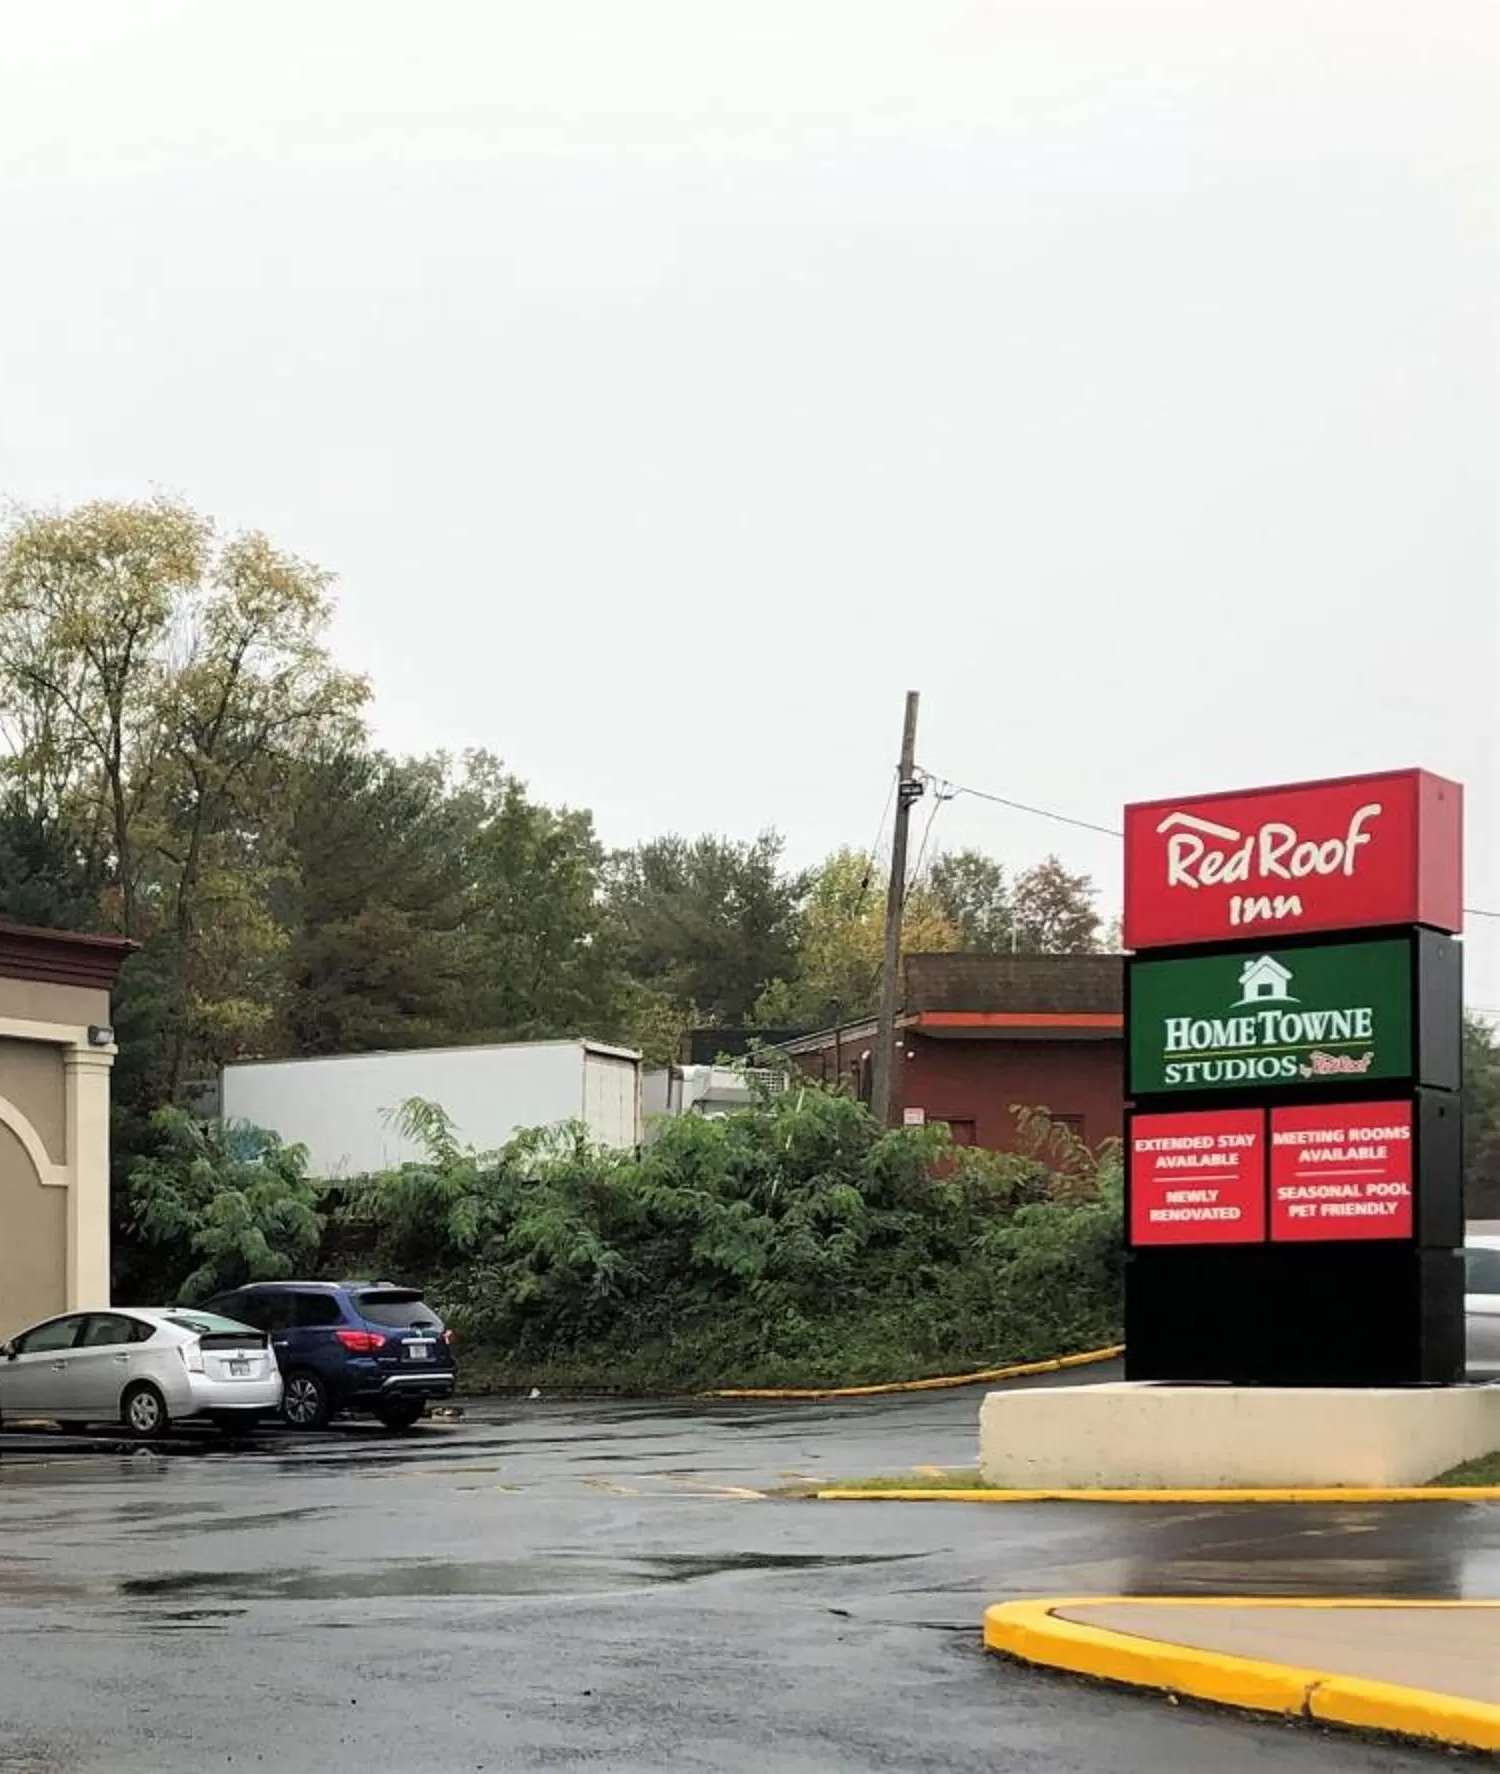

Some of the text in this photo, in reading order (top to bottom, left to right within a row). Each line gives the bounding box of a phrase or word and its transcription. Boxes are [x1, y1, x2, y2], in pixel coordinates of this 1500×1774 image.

[1167, 803, 1382, 888] Red Roof
[1165, 1056, 1297, 1084] STUDIOS
[1135, 1134, 1256, 1151] EXTENDED STAY
[1272, 1126, 1411, 1146] MEETING ROOMS
[1156, 1153, 1239, 1169] AVAILABLE
[1298, 1146, 1388, 1163] AVAILABLE
[1165, 1189, 1219, 1203] NEWLY
[1277, 1182, 1411, 1201] SEASONAL POOL
[1150, 1207, 1241, 1222] RENOVATED
[1288, 1201, 1398, 1218] PET FRIENDLY
